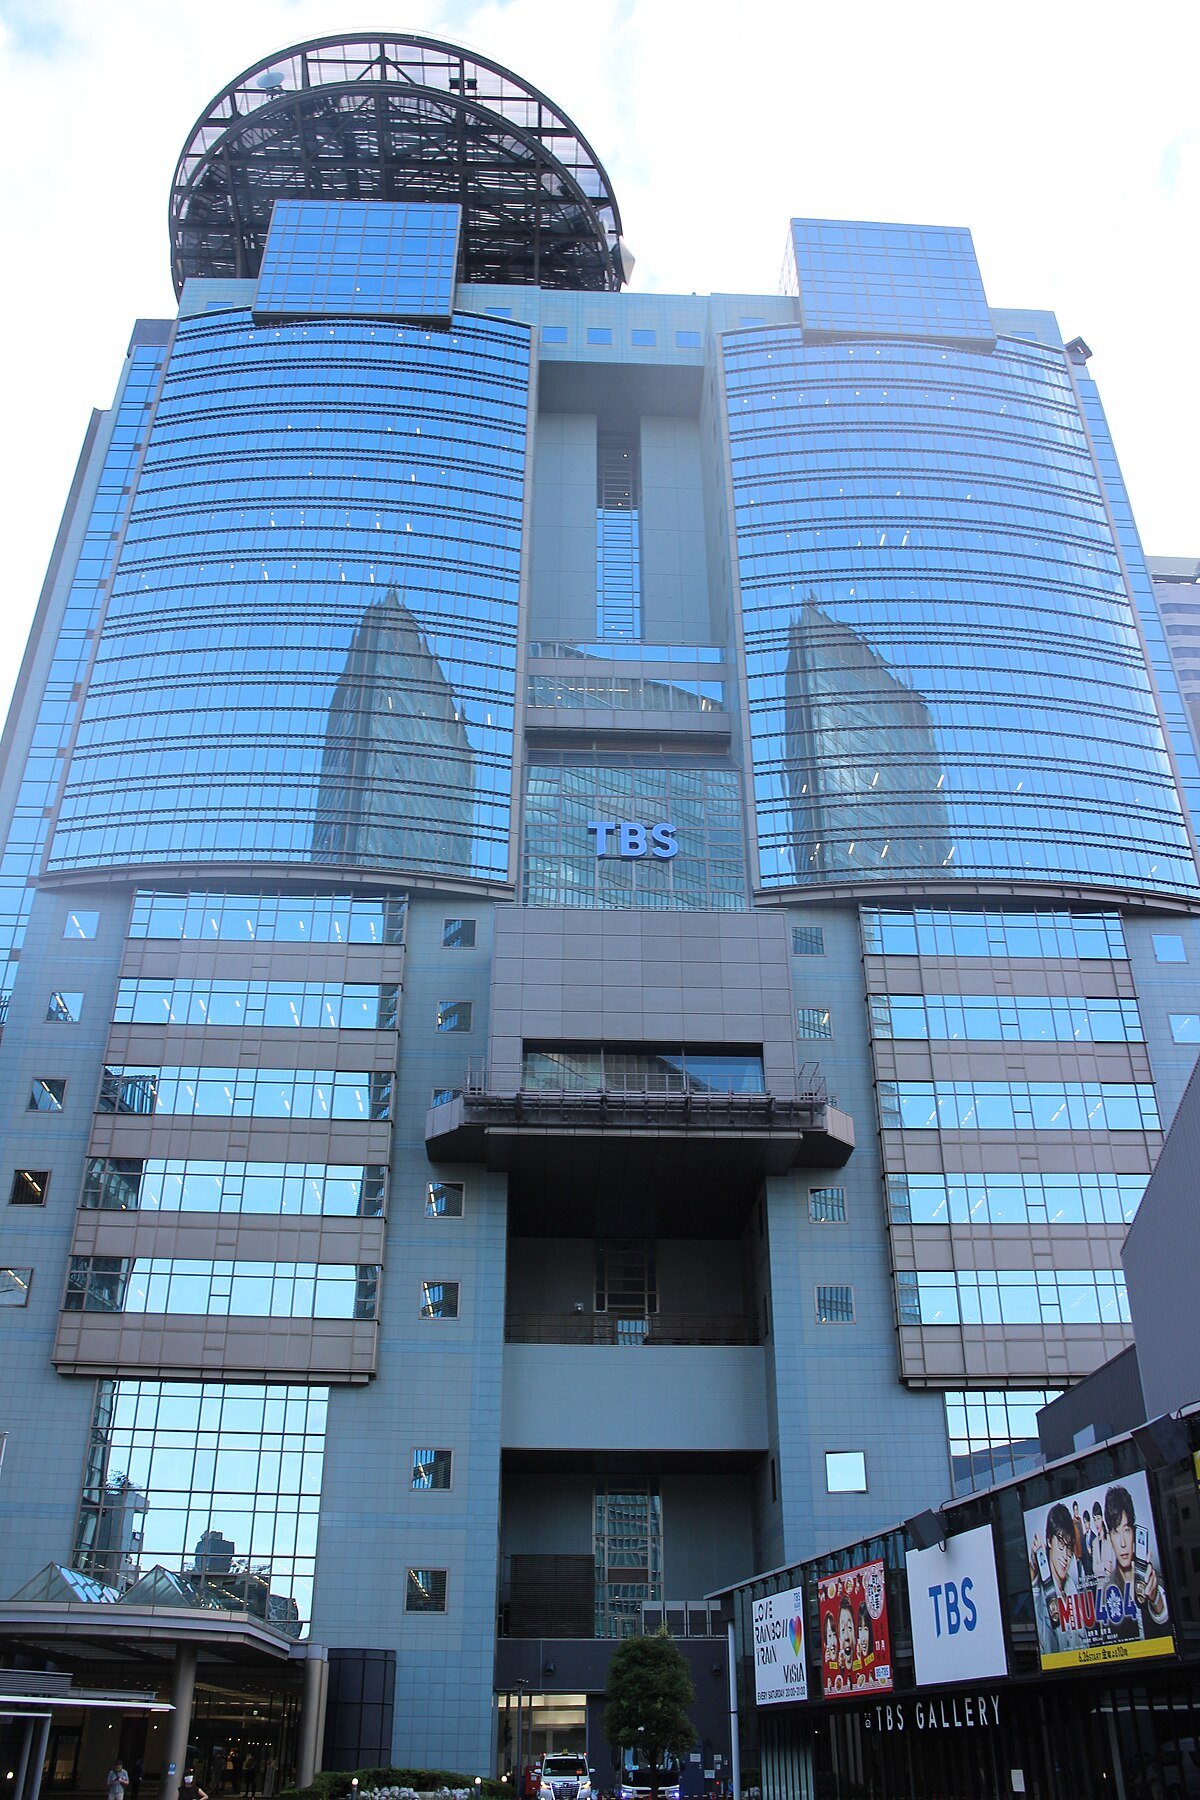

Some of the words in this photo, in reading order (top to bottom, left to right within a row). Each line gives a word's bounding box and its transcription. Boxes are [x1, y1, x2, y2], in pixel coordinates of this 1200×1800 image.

[587, 821, 679, 859] TBS
[928, 1576, 977, 1638] TBS
[1057, 1582, 1138, 1633] MIU404
[876, 1704, 904, 1732] TBS
[916, 1695, 999, 1730] GALLERY
